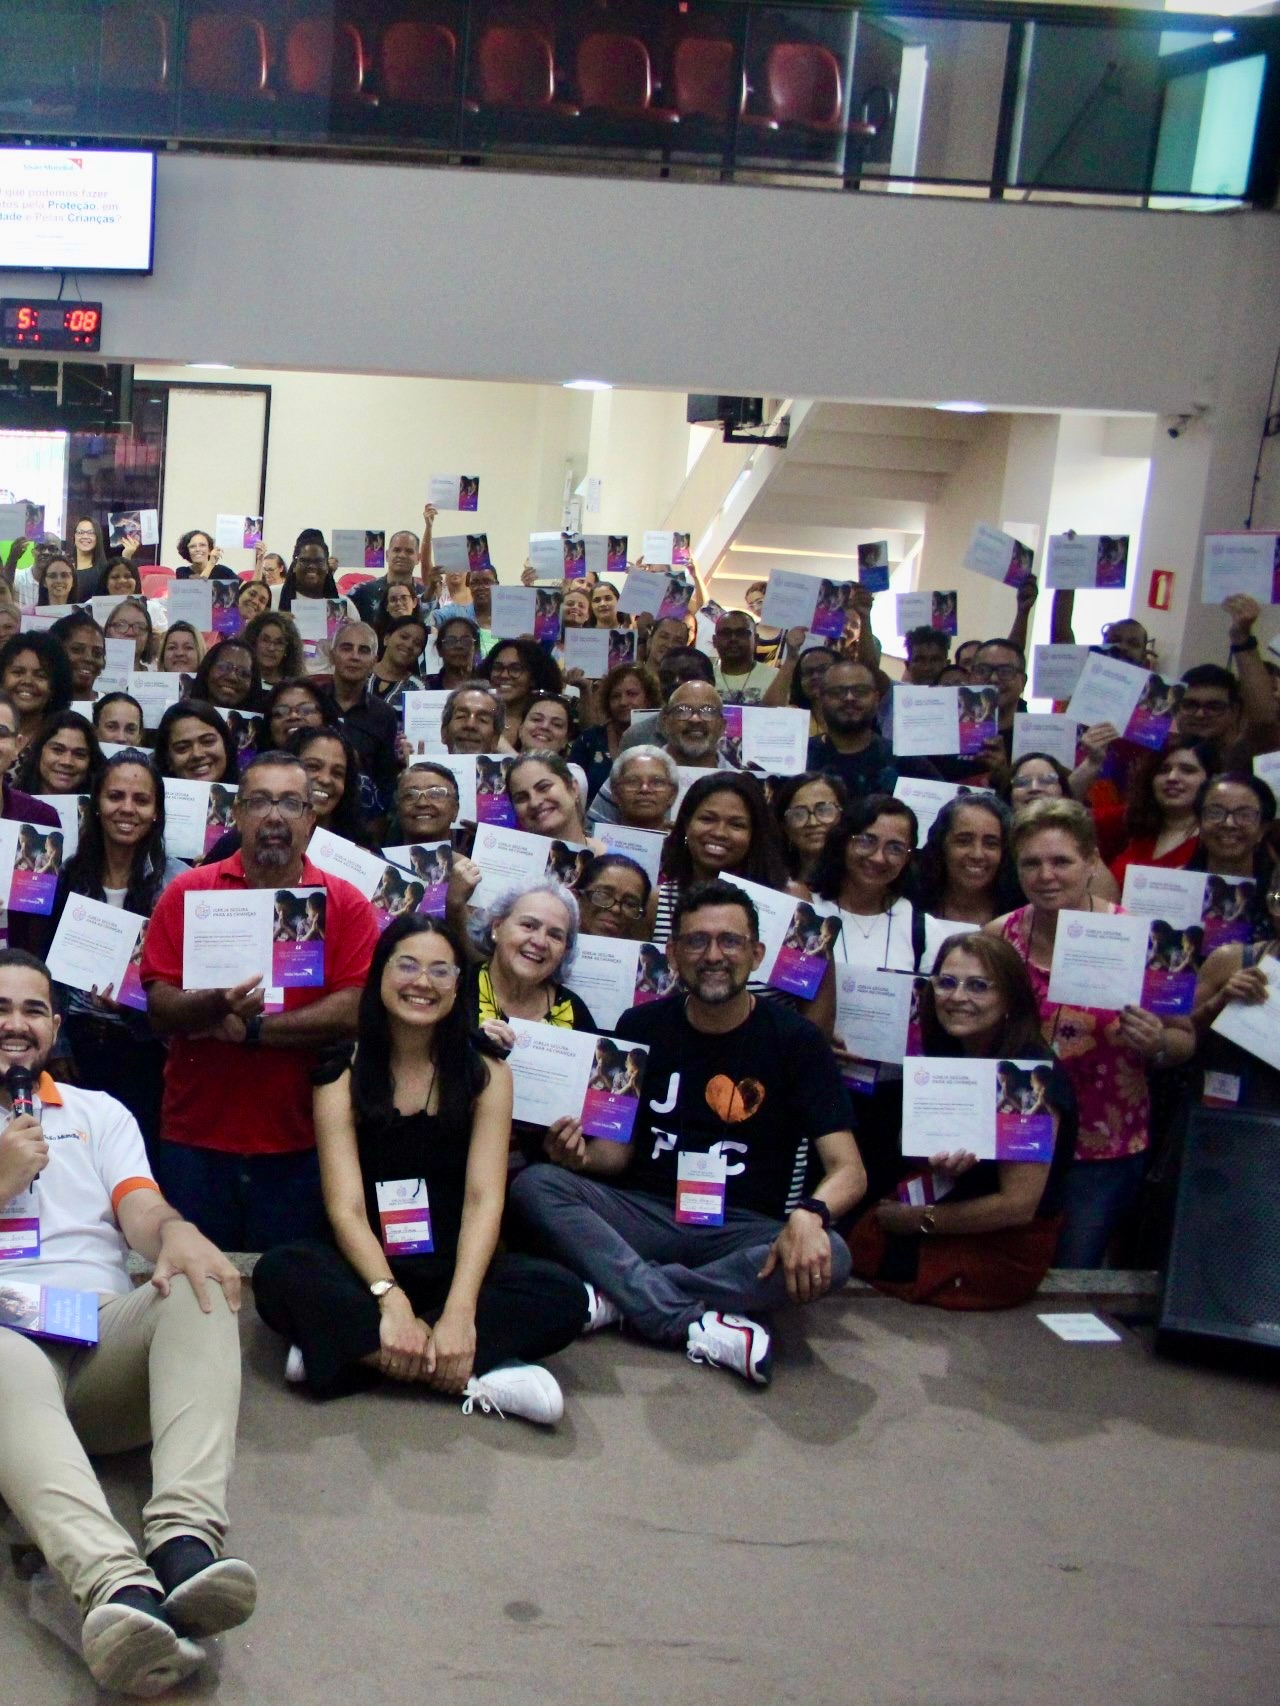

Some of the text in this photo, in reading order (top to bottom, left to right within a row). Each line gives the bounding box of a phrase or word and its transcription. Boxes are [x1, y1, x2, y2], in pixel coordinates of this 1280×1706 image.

[5, 188, 25, 199] que
[28, 188, 78, 200] podemos
[82, 188, 108, 198] fazer
[22, 200, 44, 212] pela
[35, 213, 64, 222] Pelas
[650, 1072, 680, 1114] J
